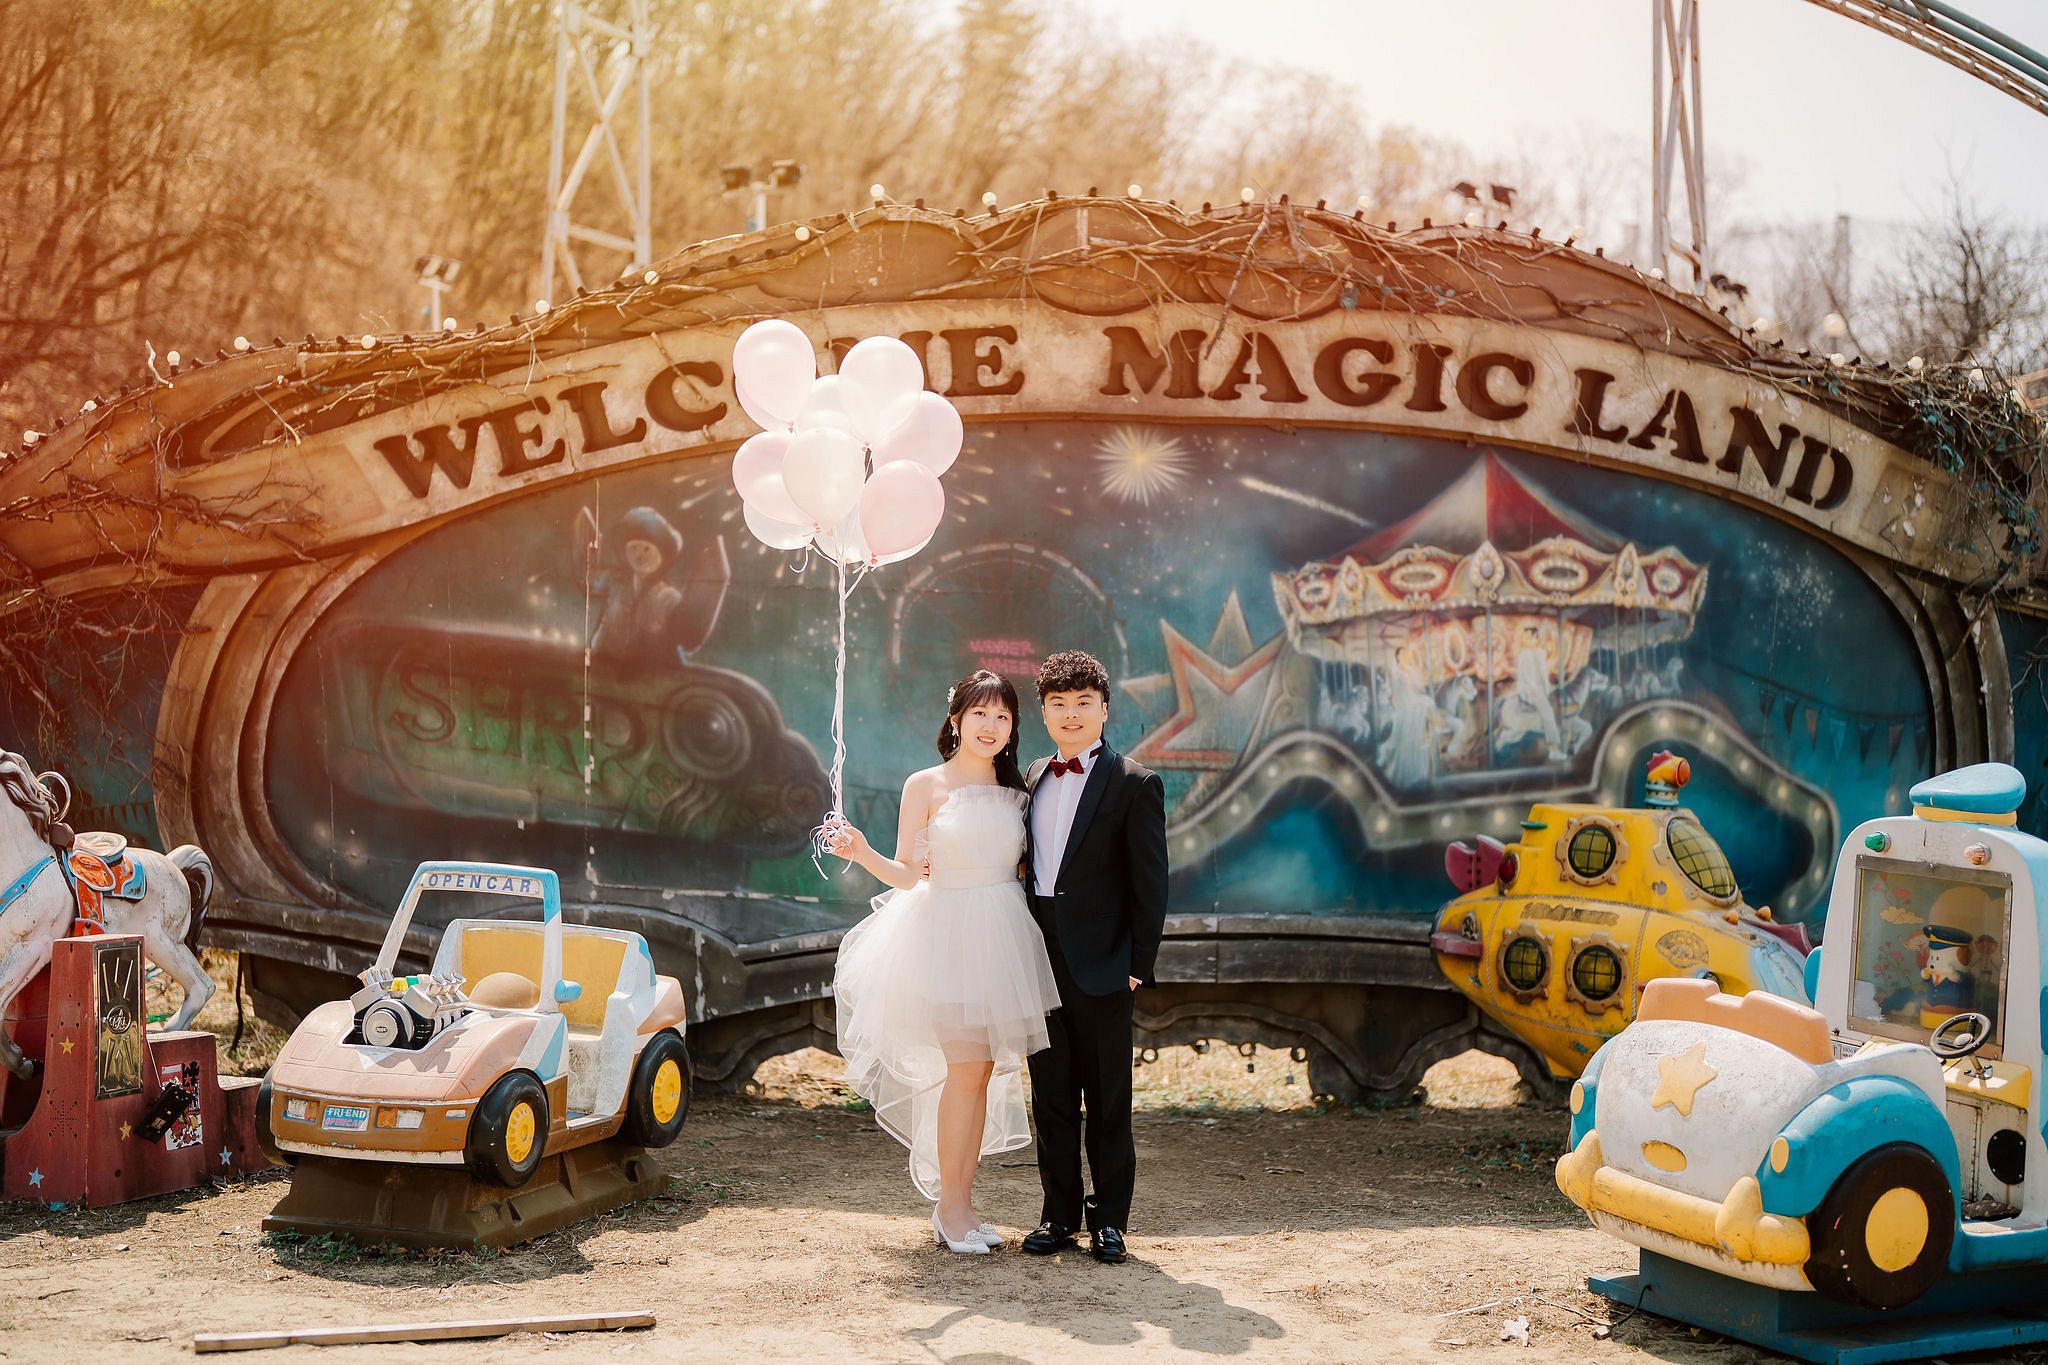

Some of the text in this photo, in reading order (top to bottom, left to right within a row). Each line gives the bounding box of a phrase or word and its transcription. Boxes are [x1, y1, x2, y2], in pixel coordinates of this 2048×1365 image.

[373, 325, 1853, 510] WELCE MAGIC LAND
[428, 873, 531, 893] OPENCAR
[327, 1107, 367, 1119] FRIEND
